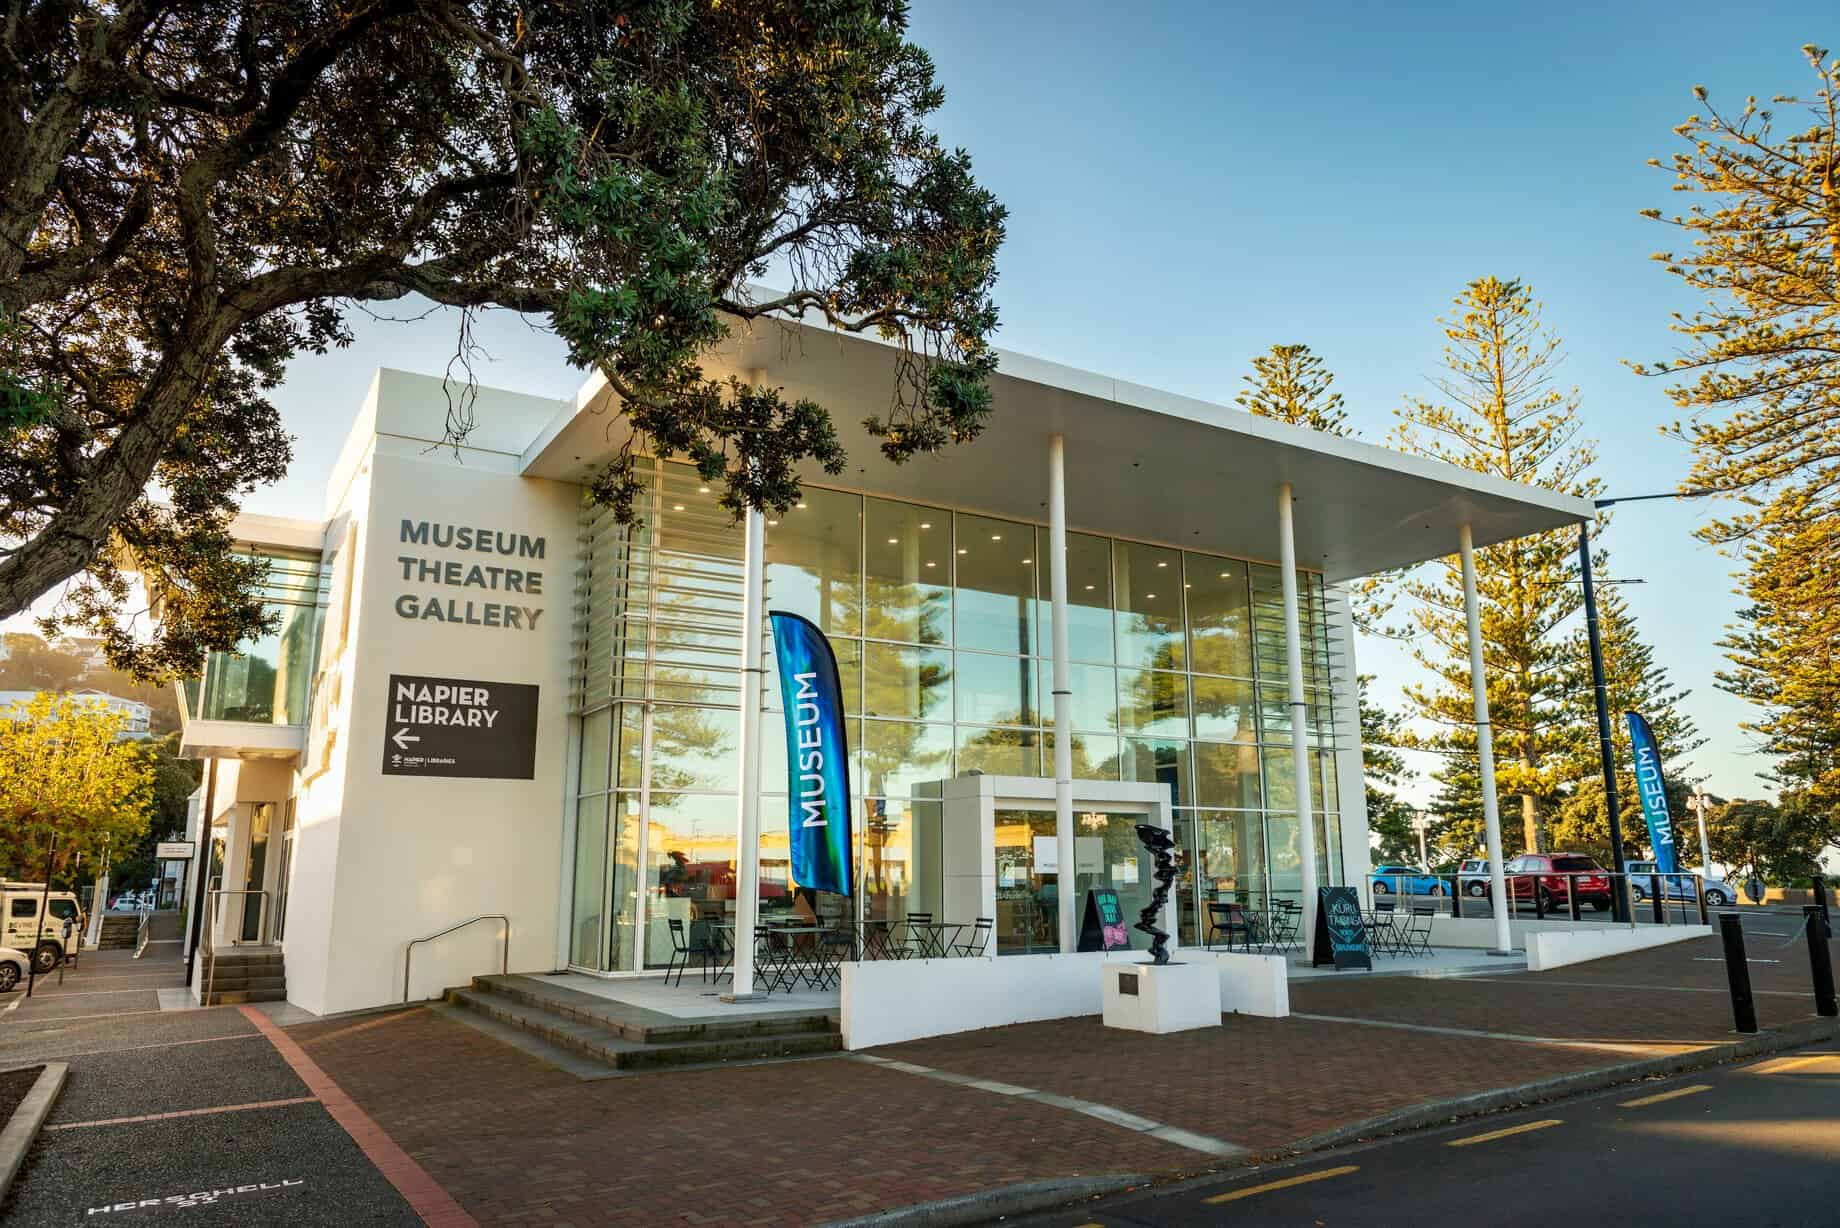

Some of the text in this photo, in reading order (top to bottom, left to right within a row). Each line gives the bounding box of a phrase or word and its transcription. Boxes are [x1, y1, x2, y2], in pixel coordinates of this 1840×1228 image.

[400, 519, 545, 559] MUSEUM
[397, 556, 543, 595] THEATRE
[394, 594, 544, 631] GALLERY
[396, 682, 490, 707] NAPIER
[395, 703, 500, 729] LIBRARY
[793, 671, 829, 828] MUSEUM
[1638, 746, 1673, 846] MUSEUM
[88, 1180, 303, 1215] HERSCHELL
